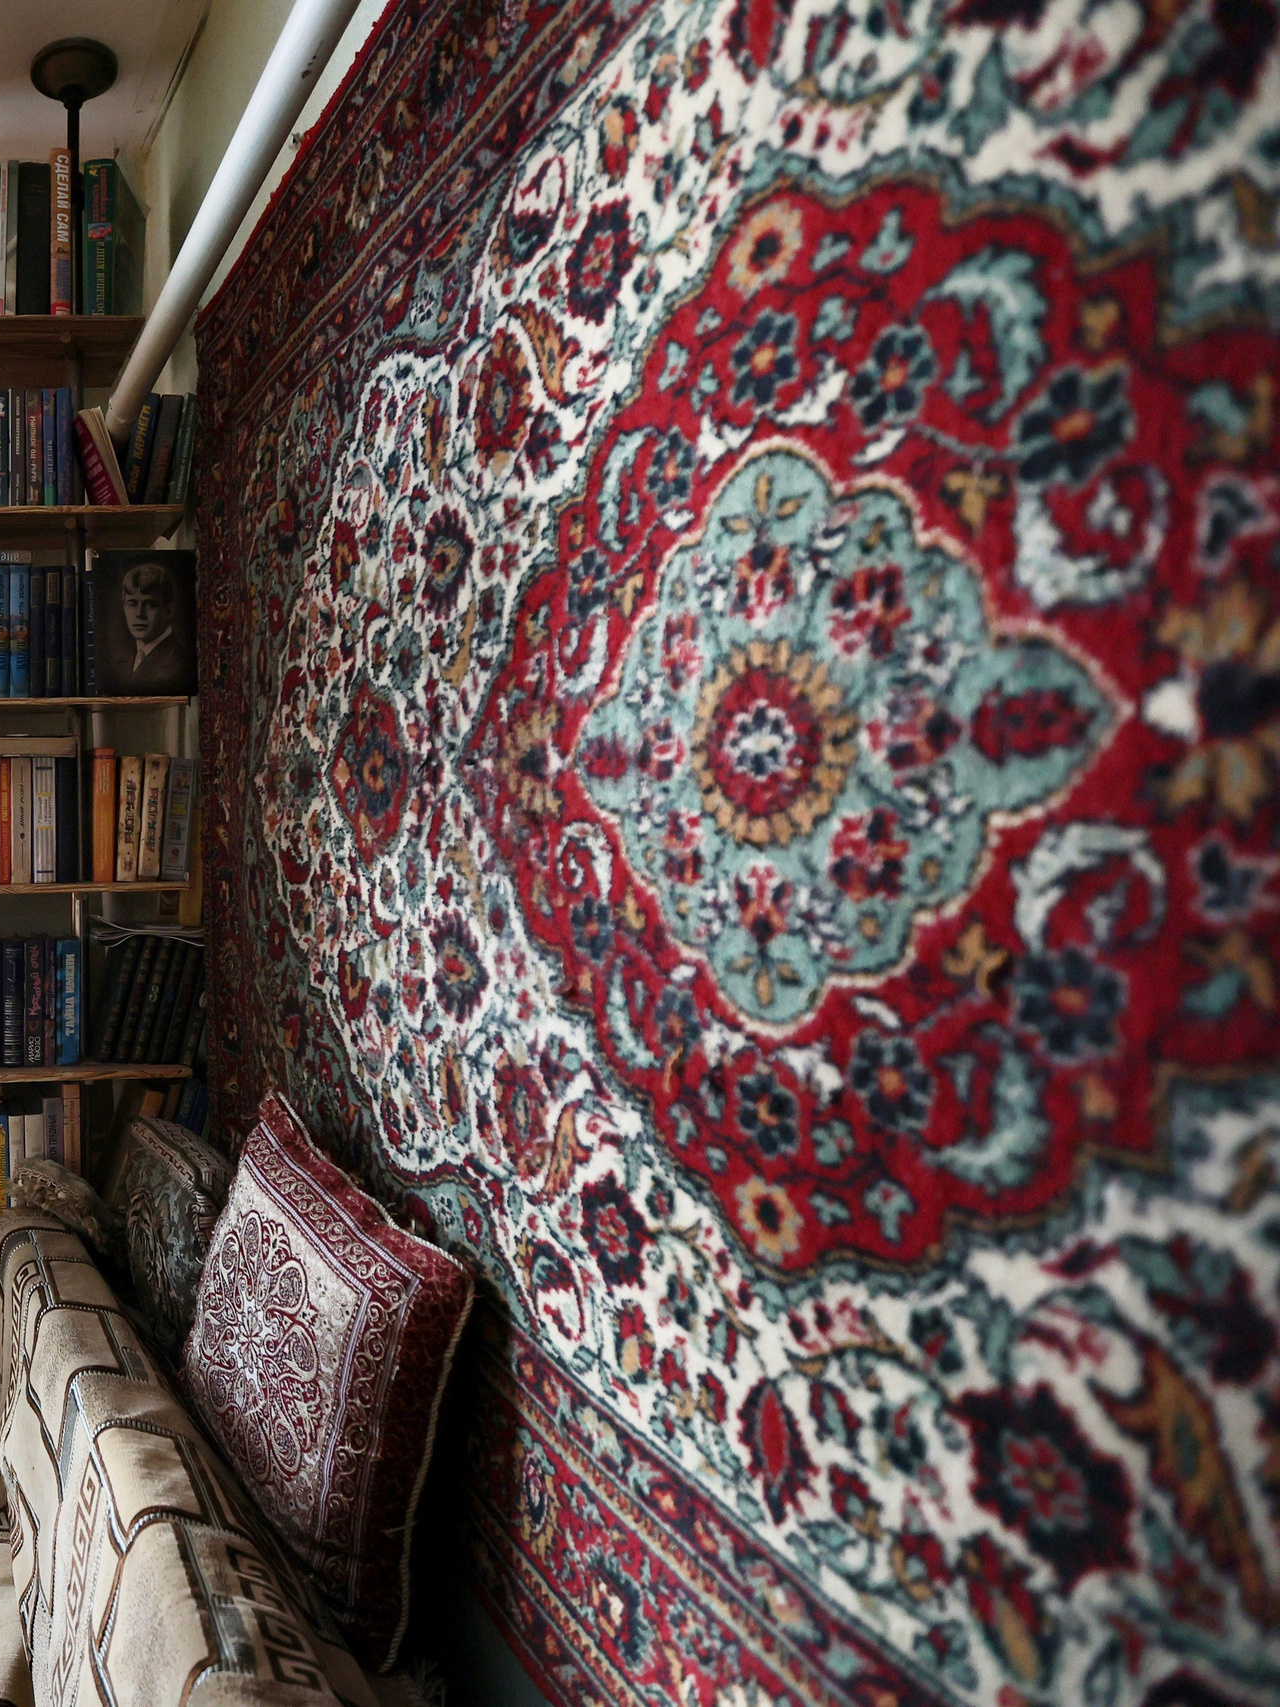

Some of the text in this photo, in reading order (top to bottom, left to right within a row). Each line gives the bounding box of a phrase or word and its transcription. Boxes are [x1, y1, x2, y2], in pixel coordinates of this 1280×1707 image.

[55, 155, 70, 242] СДЕЛАЙ САМ
[92, 241, 105, 315] Большая книга
[128, 405, 151, 493] Дейл КАРНЕГИ
[28, 946, 41, 1015] Крестный отец
[62, 954, 75, 1036] ТАЙНА ИМЕНИ
